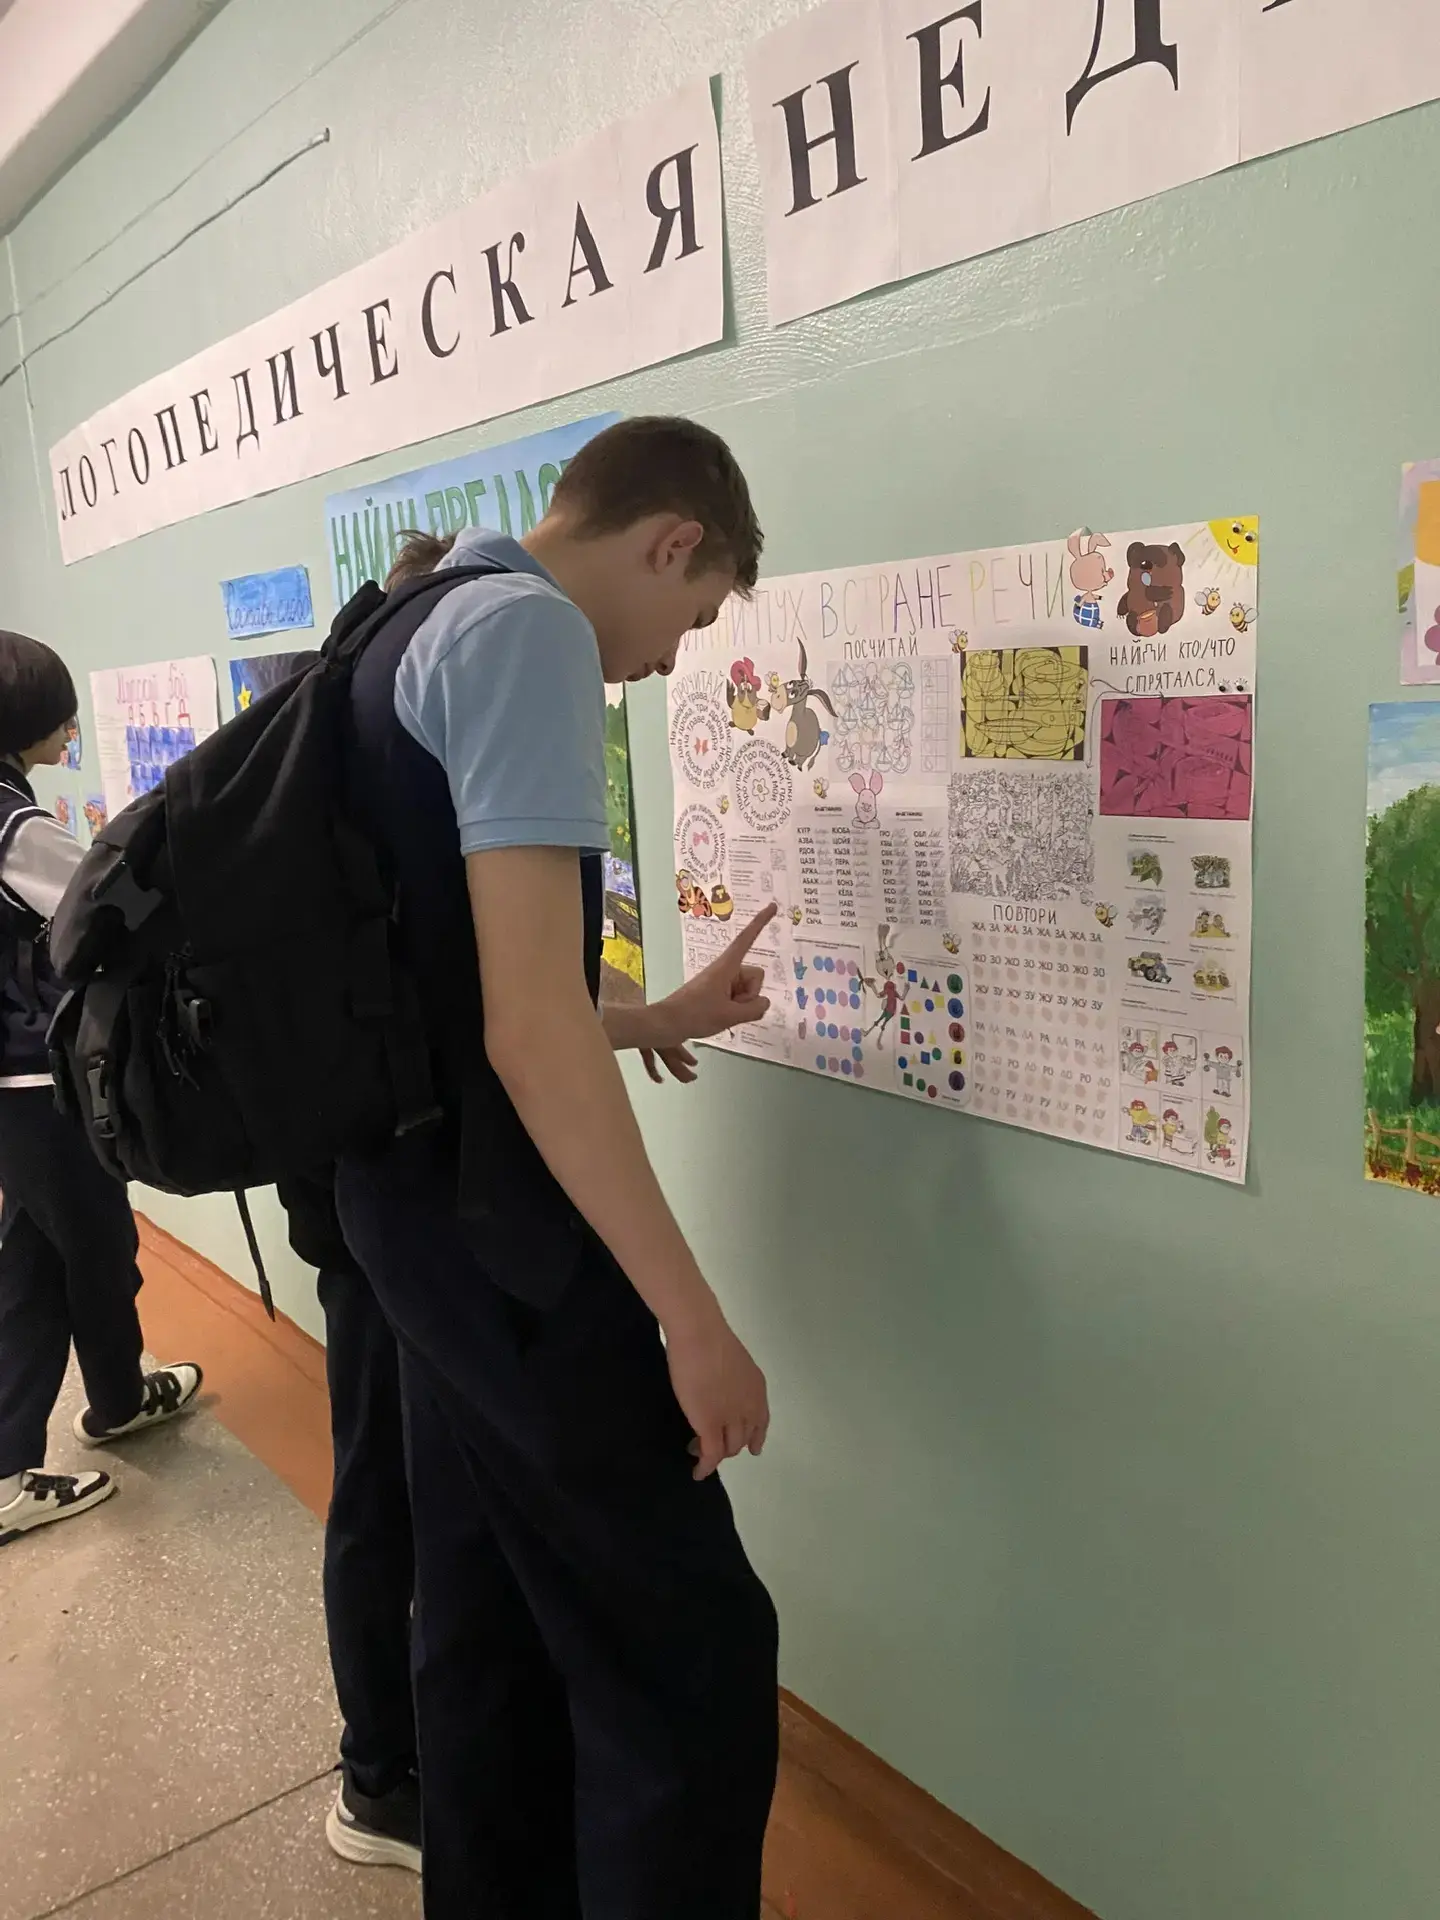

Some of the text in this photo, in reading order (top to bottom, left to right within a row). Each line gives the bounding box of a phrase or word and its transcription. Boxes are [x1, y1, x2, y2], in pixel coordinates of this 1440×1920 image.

[58, 143, 704, 521] ЛОГОПЕДИЧЕСКАЯ
[820, 581, 839, 639] В
[843, 564, 956, 635] СТРАНЕ
[970, 552, 1065, 626] РЕЧИ
[844, 631, 919, 660] ПОСЧИТАЙ
[1110, 639, 1167, 666] НАЙДИ
[1126, 668, 1216, 693] СПРЯТАЛСЯ
[992, 904, 1058, 925] ПОВТОРИ
[971, 921, 1103, 943] ЖА ЗА ЖА ЗА ЖА ЗА ЖА ЗА
[972, 953, 987, 963] ЖО
[989, 954, 1001, 965] ЗО
[1004, 956, 1020, 967] ЖО
[1023, 958, 1035, 969] ЗО
[1038, 959, 1054, 971] ЖО
[1056, 962, 1069, 973] ЗО
[1072, 964, 1089, 976] ЖО
[1092, 966, 1106, 978] ЗО
[975, 983, 1104, 1011] ЖУ ЗУ ЖУ ЗУ ЖУ ЗУ ЖУ ЗУ
[975, 1021, 986, 1031] РА
[1005, 1026, 1017, 1037] РА
[1039, 1032, 1051, 1043] РА
[1074, 1038, 1087, 1050] РА
[975, 1051, 986, 1062] РО
[1007, 1058, 1020, 1069] РО
[1042, 1064, 1055, 1076] РО
[1079, 1072, 1092, 1084] РО
[974, 1082, 985, 1093] РУ
[1006, 1088, 1017, 1100] РУ
[1040, 1096, 1052, 1108] РУ
[1075, 1104, 1088, 1116] РУ
